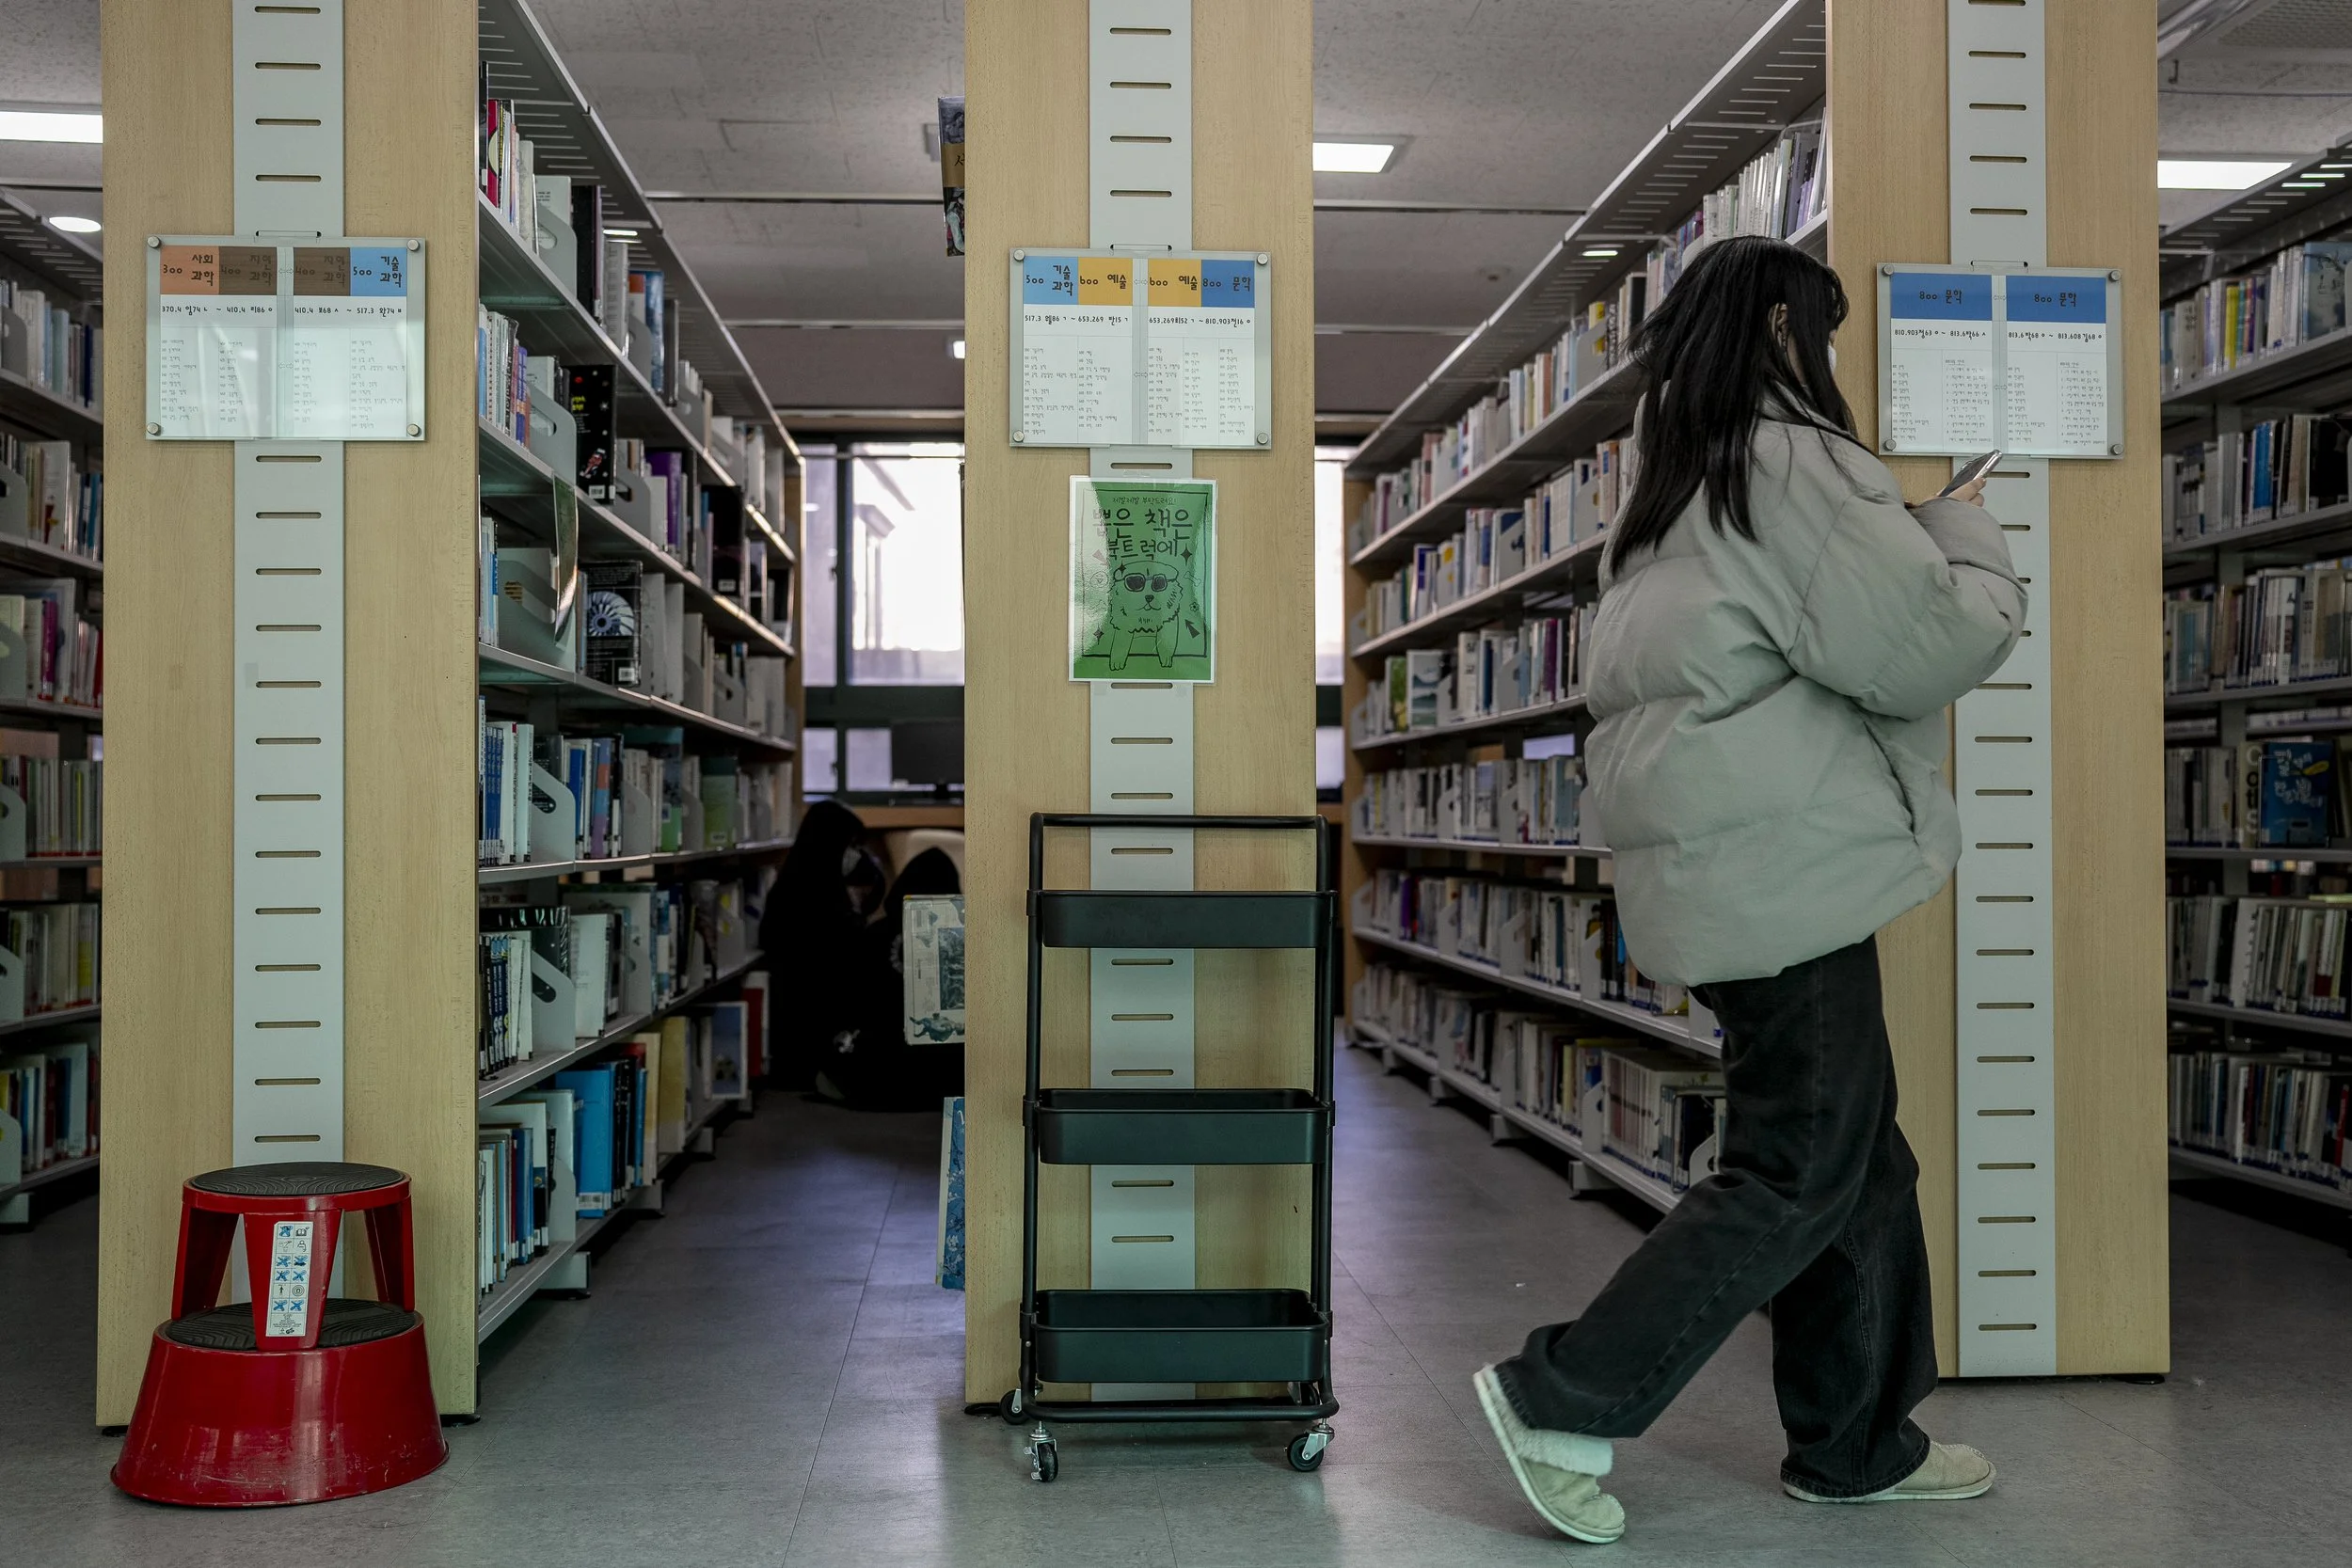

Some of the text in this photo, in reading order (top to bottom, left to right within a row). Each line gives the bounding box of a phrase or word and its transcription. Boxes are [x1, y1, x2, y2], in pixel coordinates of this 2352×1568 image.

[191, 254, 214, 265] 사회
[381, 255, 400, 271] 기술
[163, 264, 183, 275] 300
[221, 266, 241, 277] 400
[295, 267, 316, 277] 400
[353, 266, 372, 277] 500
[1052, 265, 1071, 280] 기술
[191, 271, 214, 287] 과학
[249, 271, 272, 286] 과학
[323, 272, 346, 287] 과학
[380, 272, 402, 288] 과학
[1025, 275, 1045, 285] 500
[1107, 274, 1127, 290] 예술
[1178, 275, 1198, 290] 예술
[1202, 277, 1251, 291] 800 문학
[1051, 282, 1073, 296] 과학
[1919, 289, 1962, 305] 800 문학
[2034, 292, 2077, 306] 800 문학
[1145, 508, 1193, 539] 책은
[1108, 538, 1178, 560] 북트럭에
